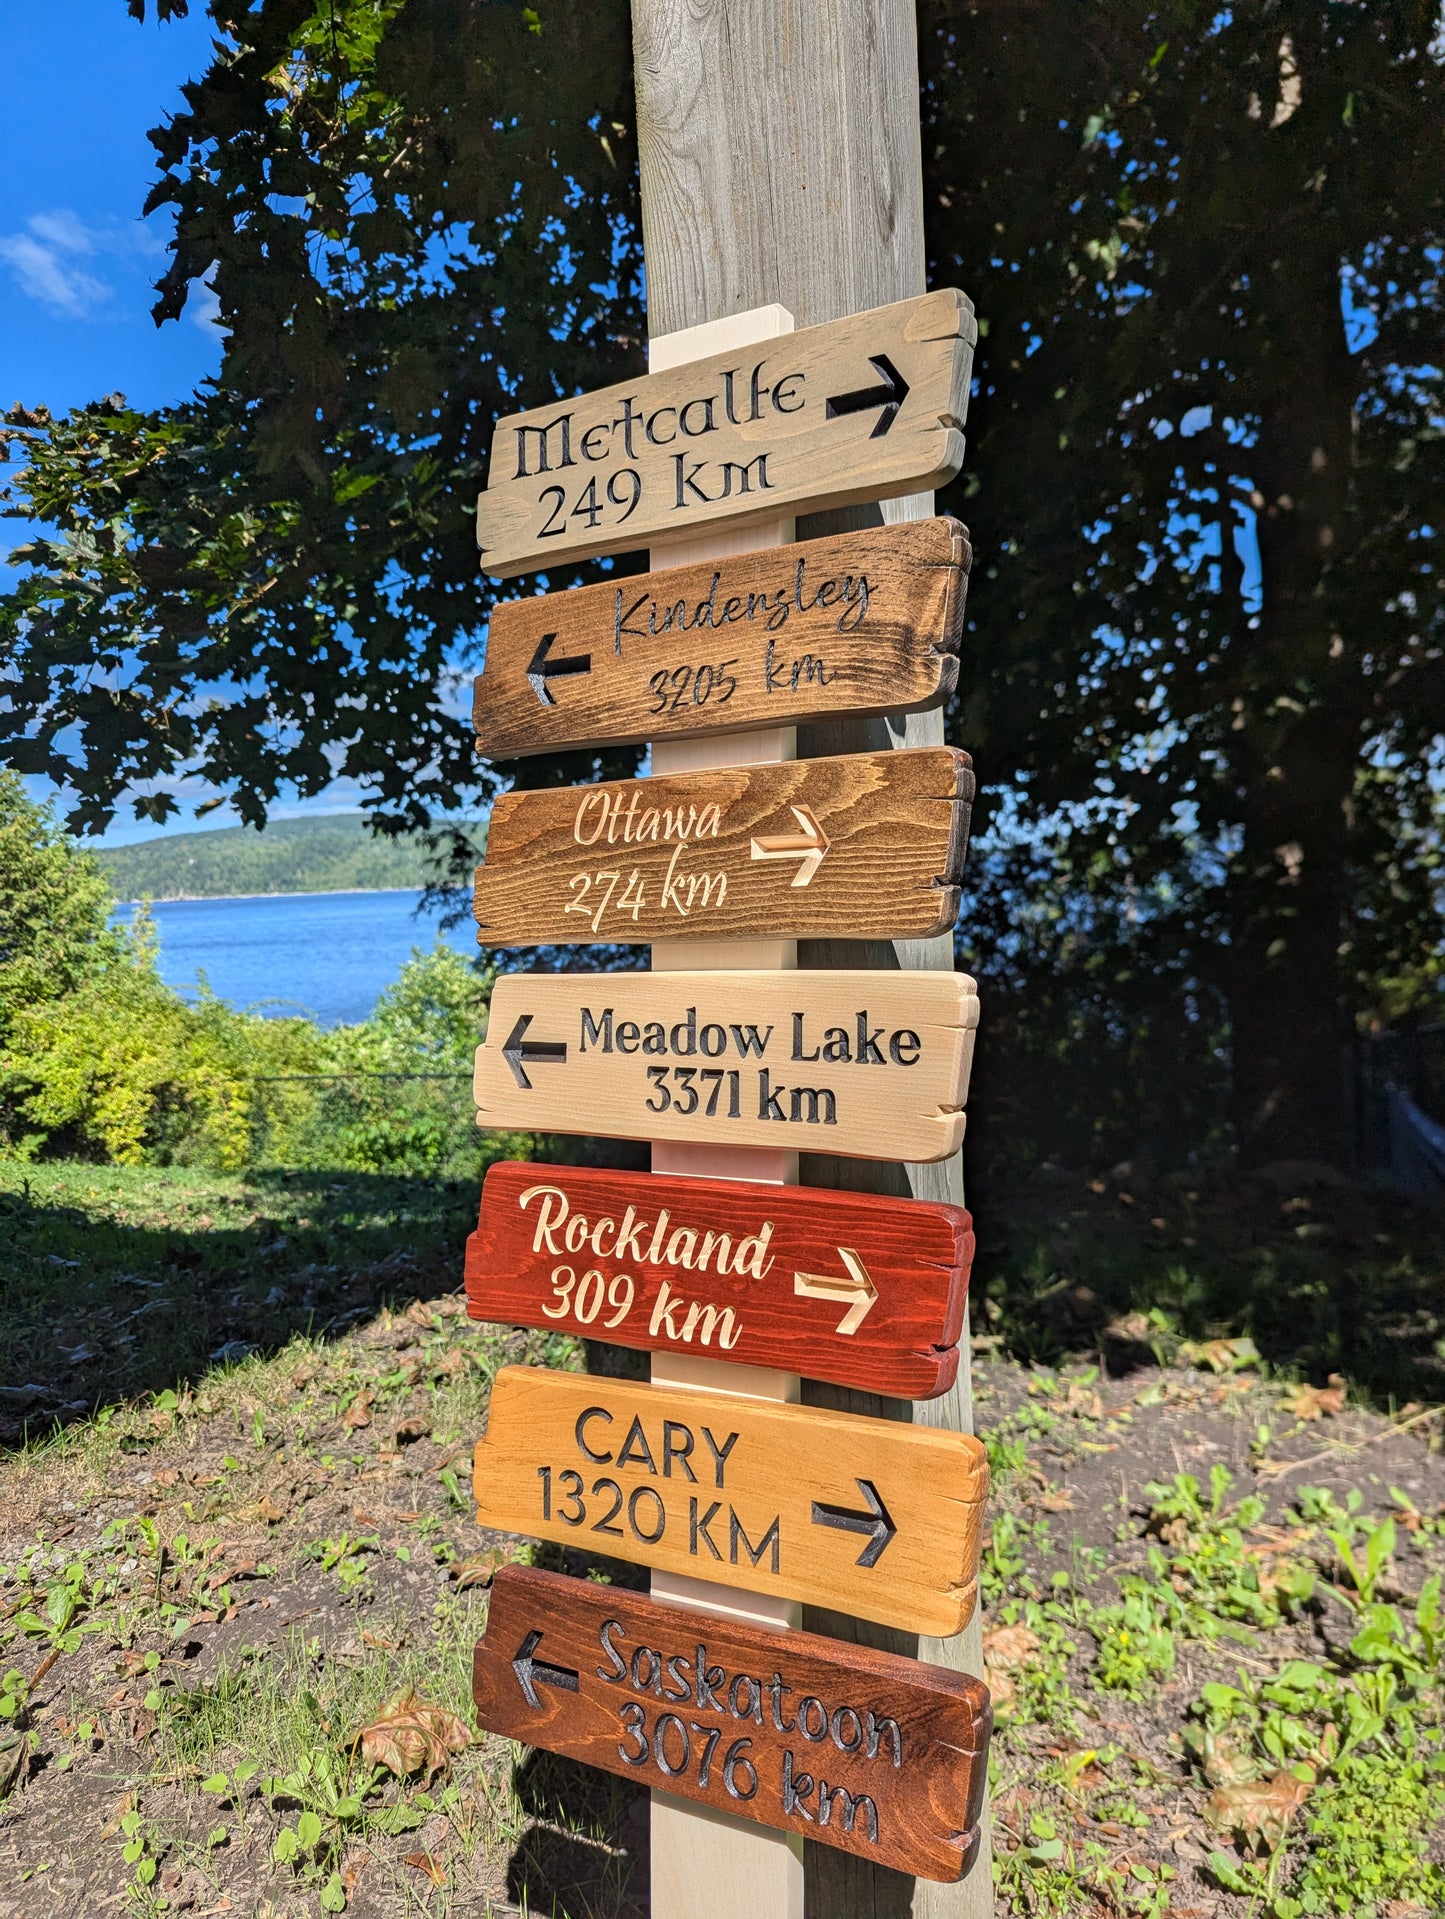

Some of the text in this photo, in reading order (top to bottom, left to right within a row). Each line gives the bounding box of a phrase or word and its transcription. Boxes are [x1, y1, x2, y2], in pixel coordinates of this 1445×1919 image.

[511, 360, 807, 481] Metcalfe
[536, 468, 642, 539] 249
[614, 558, 878, 656] Kindersley
[649, 639, 836, 714] 3205 km
[573, 788, 722, 845] Ottawa
[564, 843, 728, 933] 274 km
[579, 1006, 922, 1066] Meadow Lake
[646, 1066, 838, 1124] 3371 km
[519, 1185, 775, 1280] Rockland
[541, 1265, 744, 1351] 309 km
[575, 1407, 741, 1489] CARY
[537, 1466, 781, 1575] 1320 KM
[597, 1619, 902, 1768] Saskatoon
[617, 1702, 880, 1845] 3076 km
